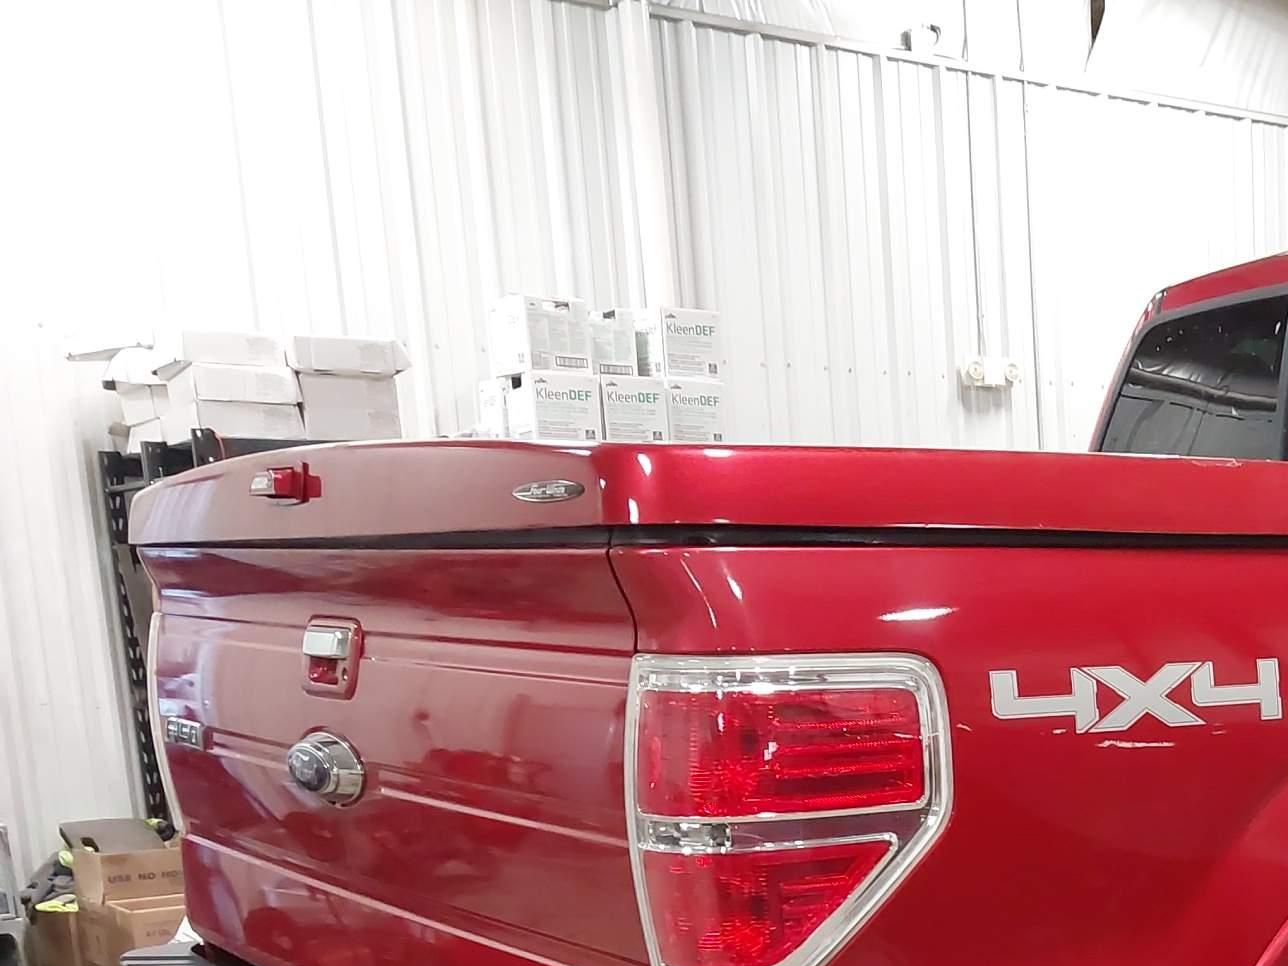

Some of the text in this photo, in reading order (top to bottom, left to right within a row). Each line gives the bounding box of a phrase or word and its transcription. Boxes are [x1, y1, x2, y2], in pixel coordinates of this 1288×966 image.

[666, 322, 716, 337] KleenDEF
[535, 387, 592, 402] KleenDEF
[606, 391, 660, 404] KleenDEF
[671, 393, 720, 407] KleenDEF
